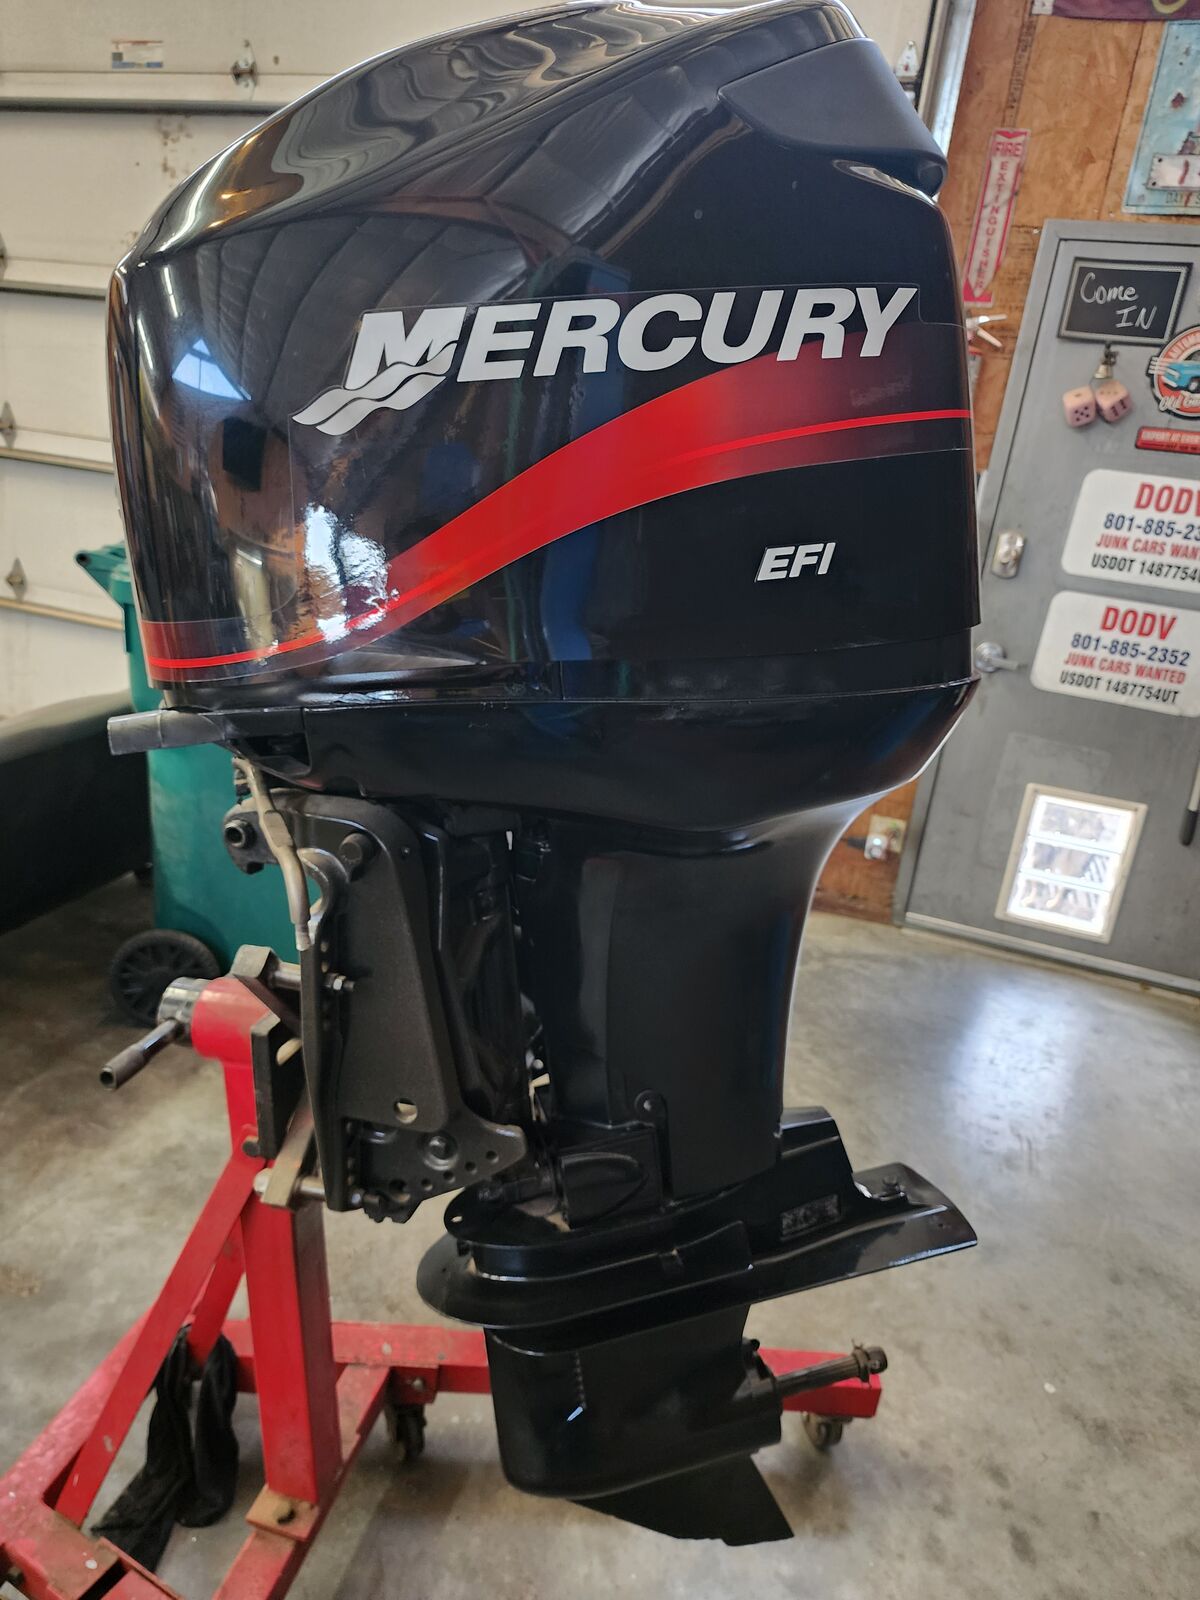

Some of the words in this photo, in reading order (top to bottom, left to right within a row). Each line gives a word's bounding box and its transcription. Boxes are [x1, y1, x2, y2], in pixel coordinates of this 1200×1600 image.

[992, 142, 1024, 157] FIRE
[975, 161, 1009, 289] EXTINGUISHER
[1081, 272, 1139, 304] Come
[1115, 305, 1158, 330] IN
[343, 287, 918, 391] MERCURY
[1134, 483, 1200, 517] DOD
[757, 542, 836, 581] EFI
[1096, 534, 1130, 551] JUNK
[1132, 539, 1167, 556] CARS
[1170, 543, 1200, 560] WAN
[1091, 554, 1136, 573] USDOT
[1140, 562, 1200, 583] 1487754
[1101, 606, 1177, 641] DODV
[1071, 633, 1191, 667] 801-885-2352
[1064, 652, 1096, 668] JUNK
[1099, 658, 1132, 675] CARS
[1135, 664, 1187, 685] WANTED
[1059, 670, 1102, 690] USDOT
[1106, 679, 1180, 704] 1487754UT
